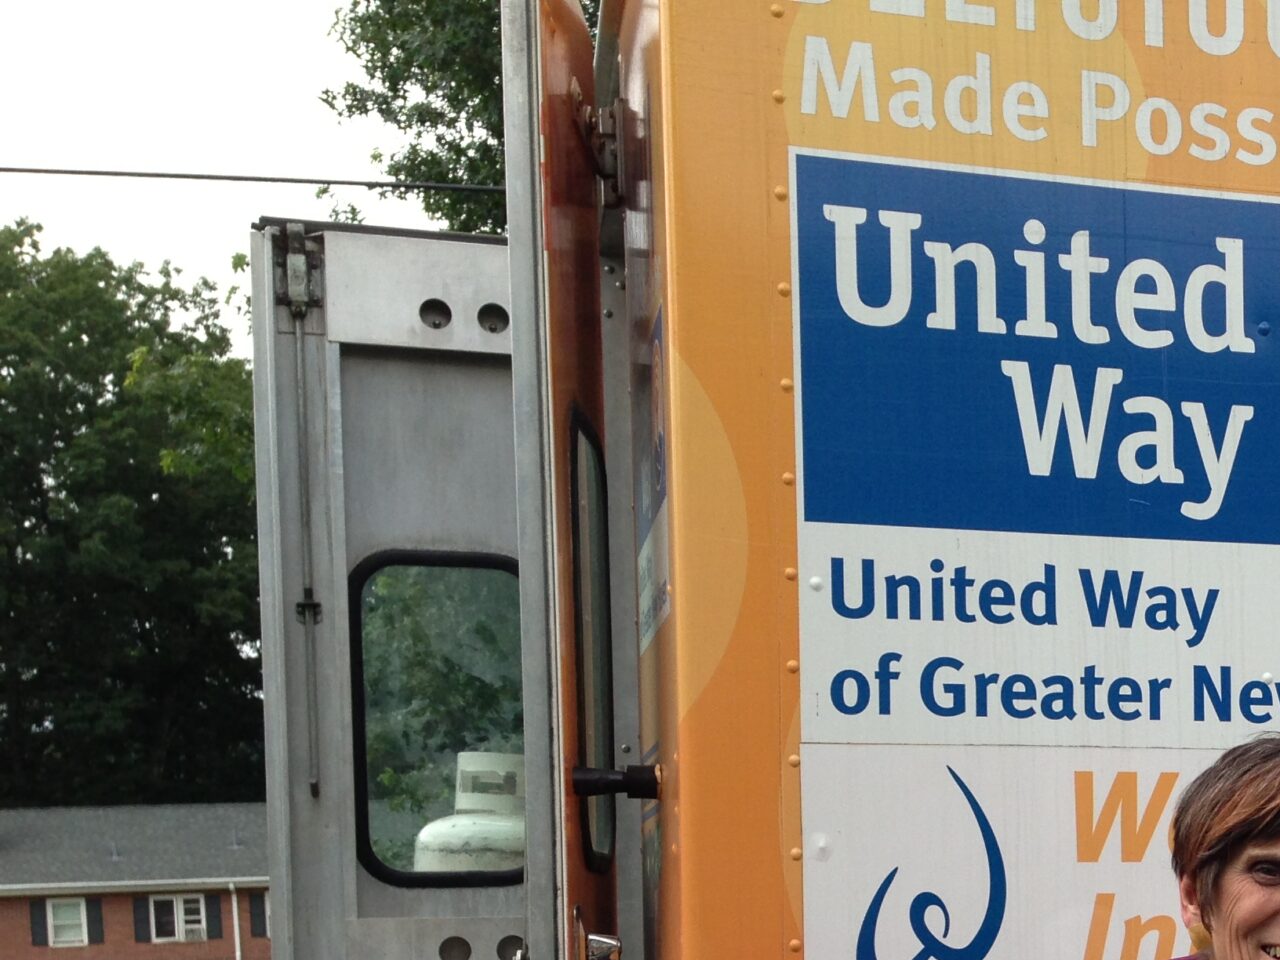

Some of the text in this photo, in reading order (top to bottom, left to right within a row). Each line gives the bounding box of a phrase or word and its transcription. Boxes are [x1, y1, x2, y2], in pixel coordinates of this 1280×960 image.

[800, 36, 1050, 142] Made
[823, 204, 1256, 354] United
[1001, 359, 1255, 521] Way
[830, 556, 1220, 648] United Way
[830, 652, 902, 716] of
[919, 656, 1172, 722] Greater
